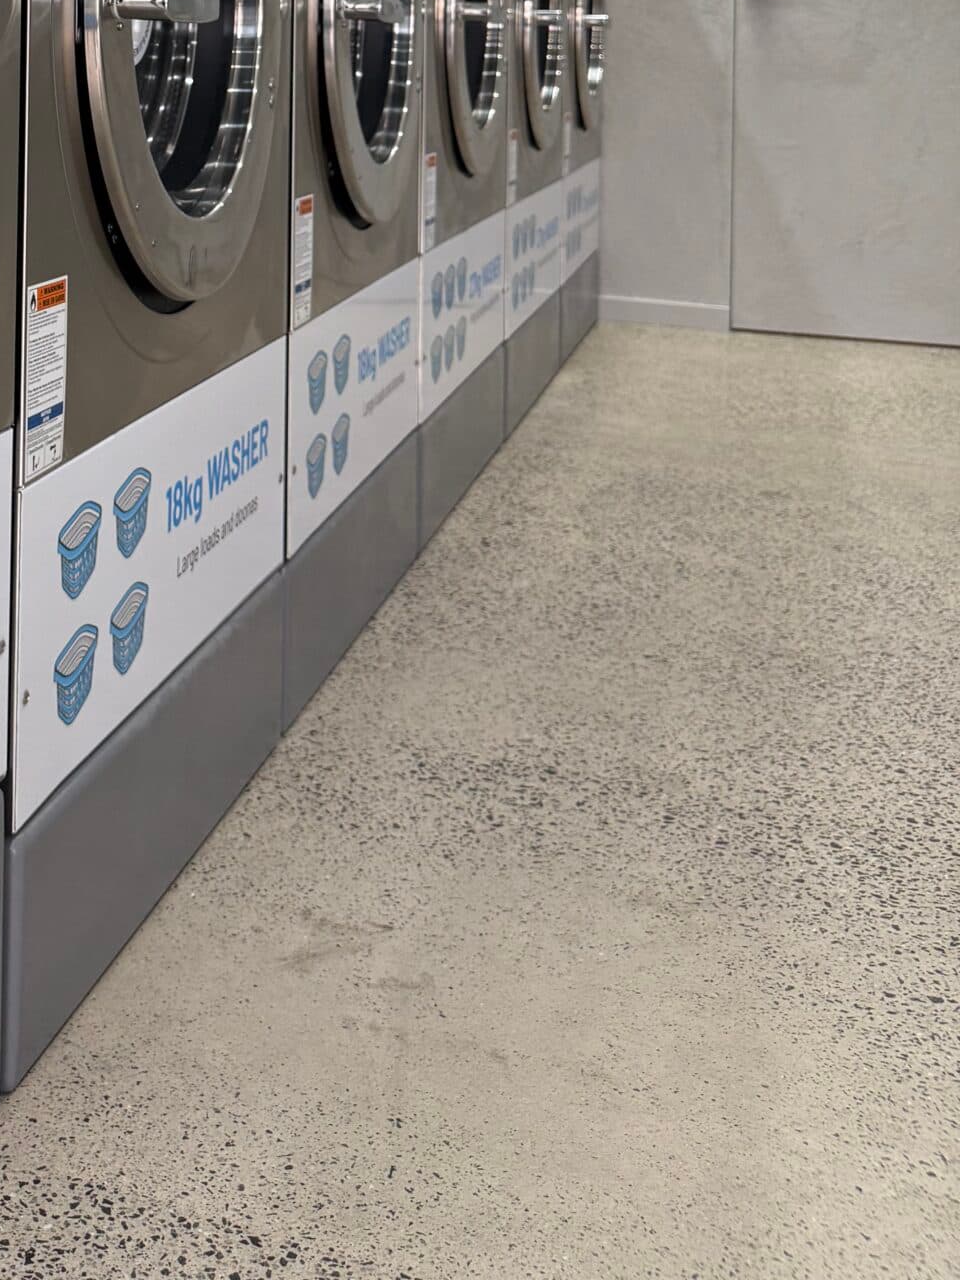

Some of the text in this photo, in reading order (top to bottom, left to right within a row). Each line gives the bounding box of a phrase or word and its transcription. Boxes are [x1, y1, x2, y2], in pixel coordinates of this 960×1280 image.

[166, 419, 269, 534] 18kg WASHER
[177, 546, 199, 578] Large
[200, 527, 220, 556] loads
[221, 512, 233, 539] and
